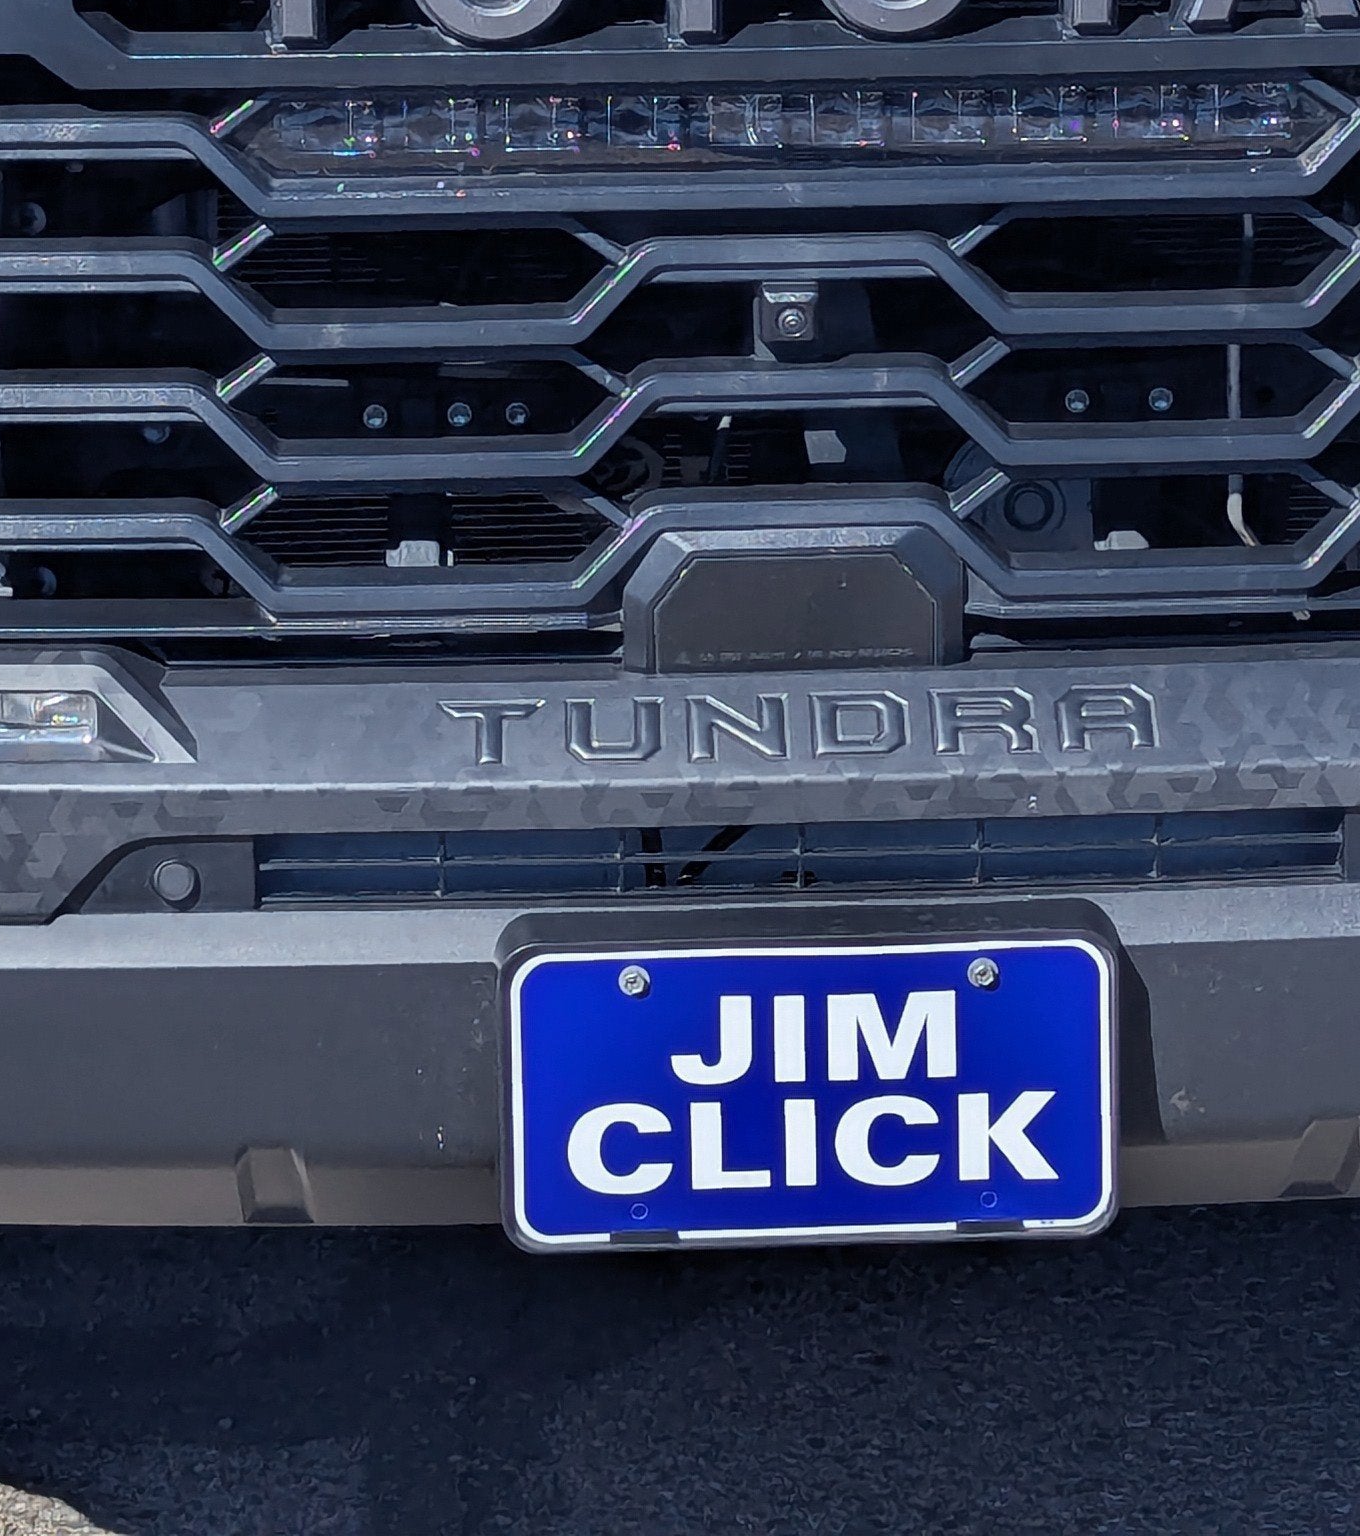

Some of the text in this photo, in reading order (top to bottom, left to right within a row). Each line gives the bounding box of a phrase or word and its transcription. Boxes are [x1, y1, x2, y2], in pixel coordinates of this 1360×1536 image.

[438, 683, 1161, 764] TUNDRA
[670, 990, 957, 1085] JIM
[567, 1090, 1060, 1195] CLICK
